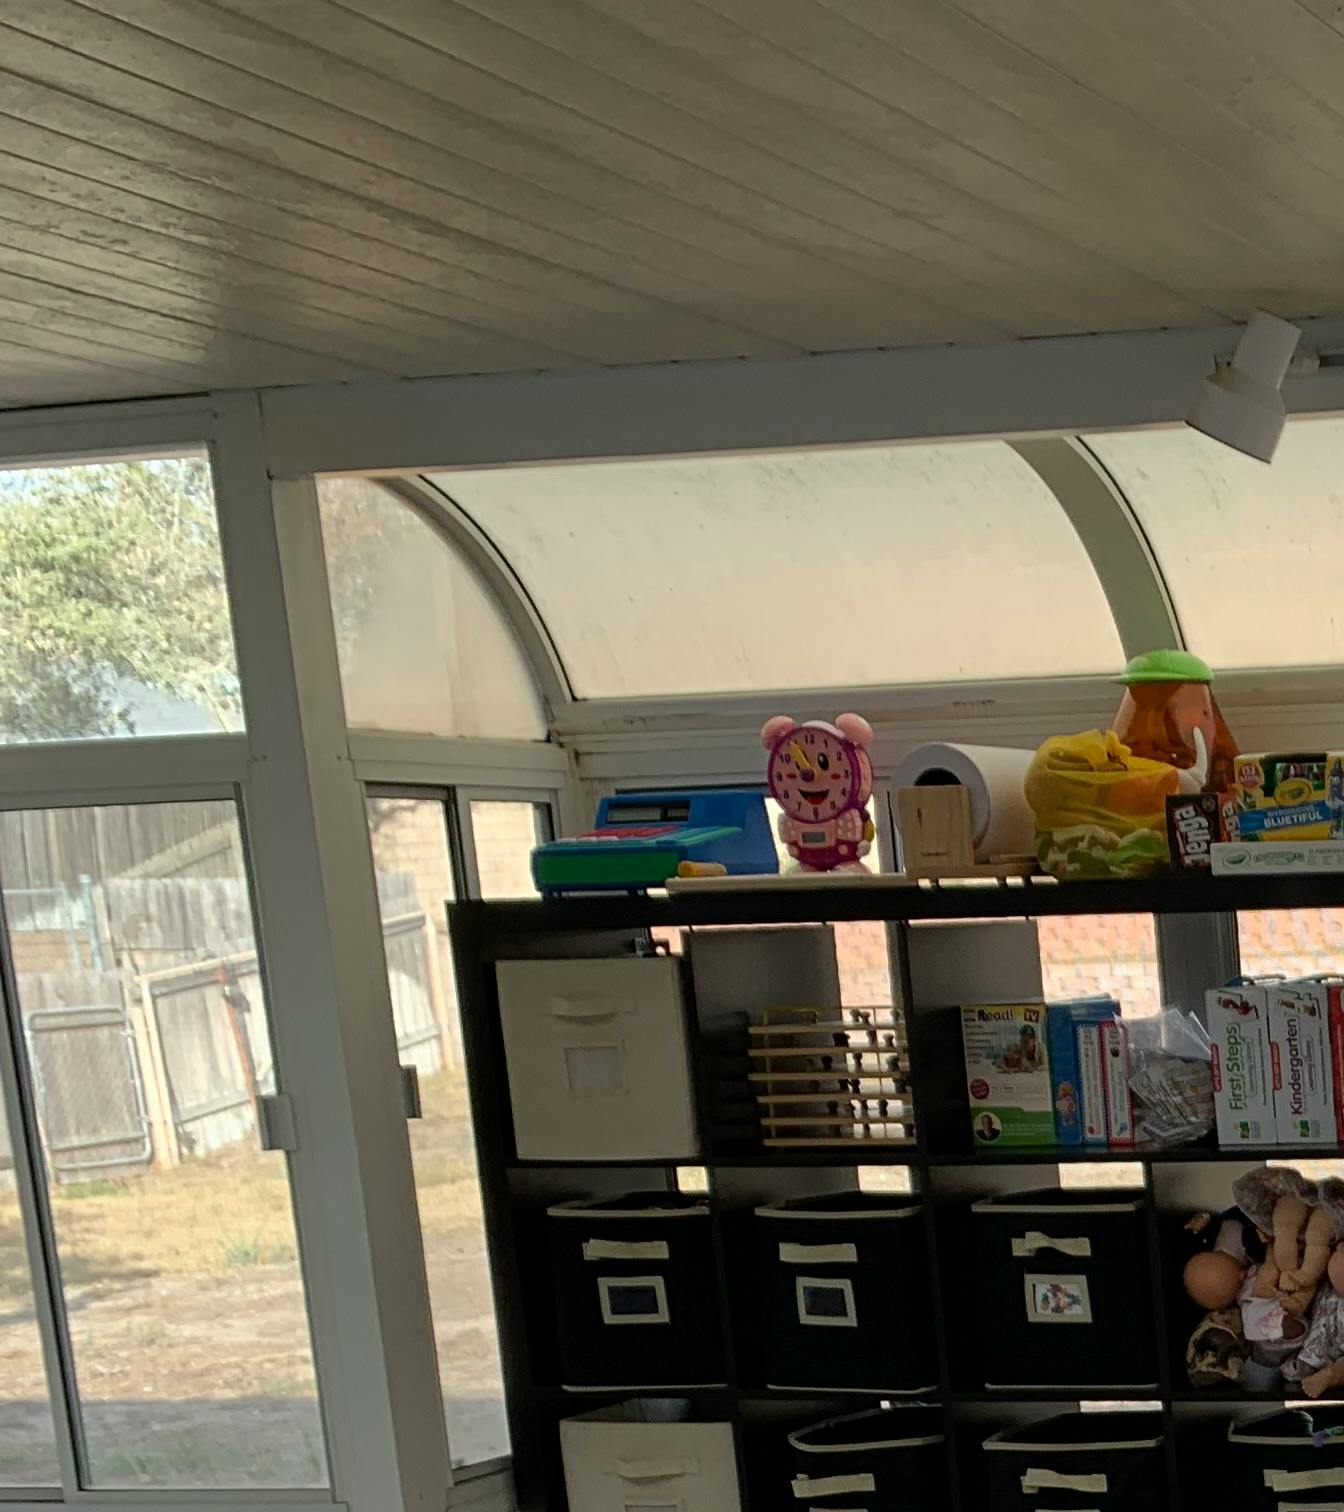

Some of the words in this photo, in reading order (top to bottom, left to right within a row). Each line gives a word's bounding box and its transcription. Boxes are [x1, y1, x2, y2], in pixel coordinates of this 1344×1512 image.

[804, 733, 816, 745] 12
[779, 753, 791, 764] 10
[1263, 811, 1324, 829] BLUETIFUL
[977, 1009, 1013, 1022] Read!
[1225, 1023, 1243, 1074] Steps
[1286, 1017, 1304, 1116] Kindergarten
[1228, 1076, 1244, 1111] First
